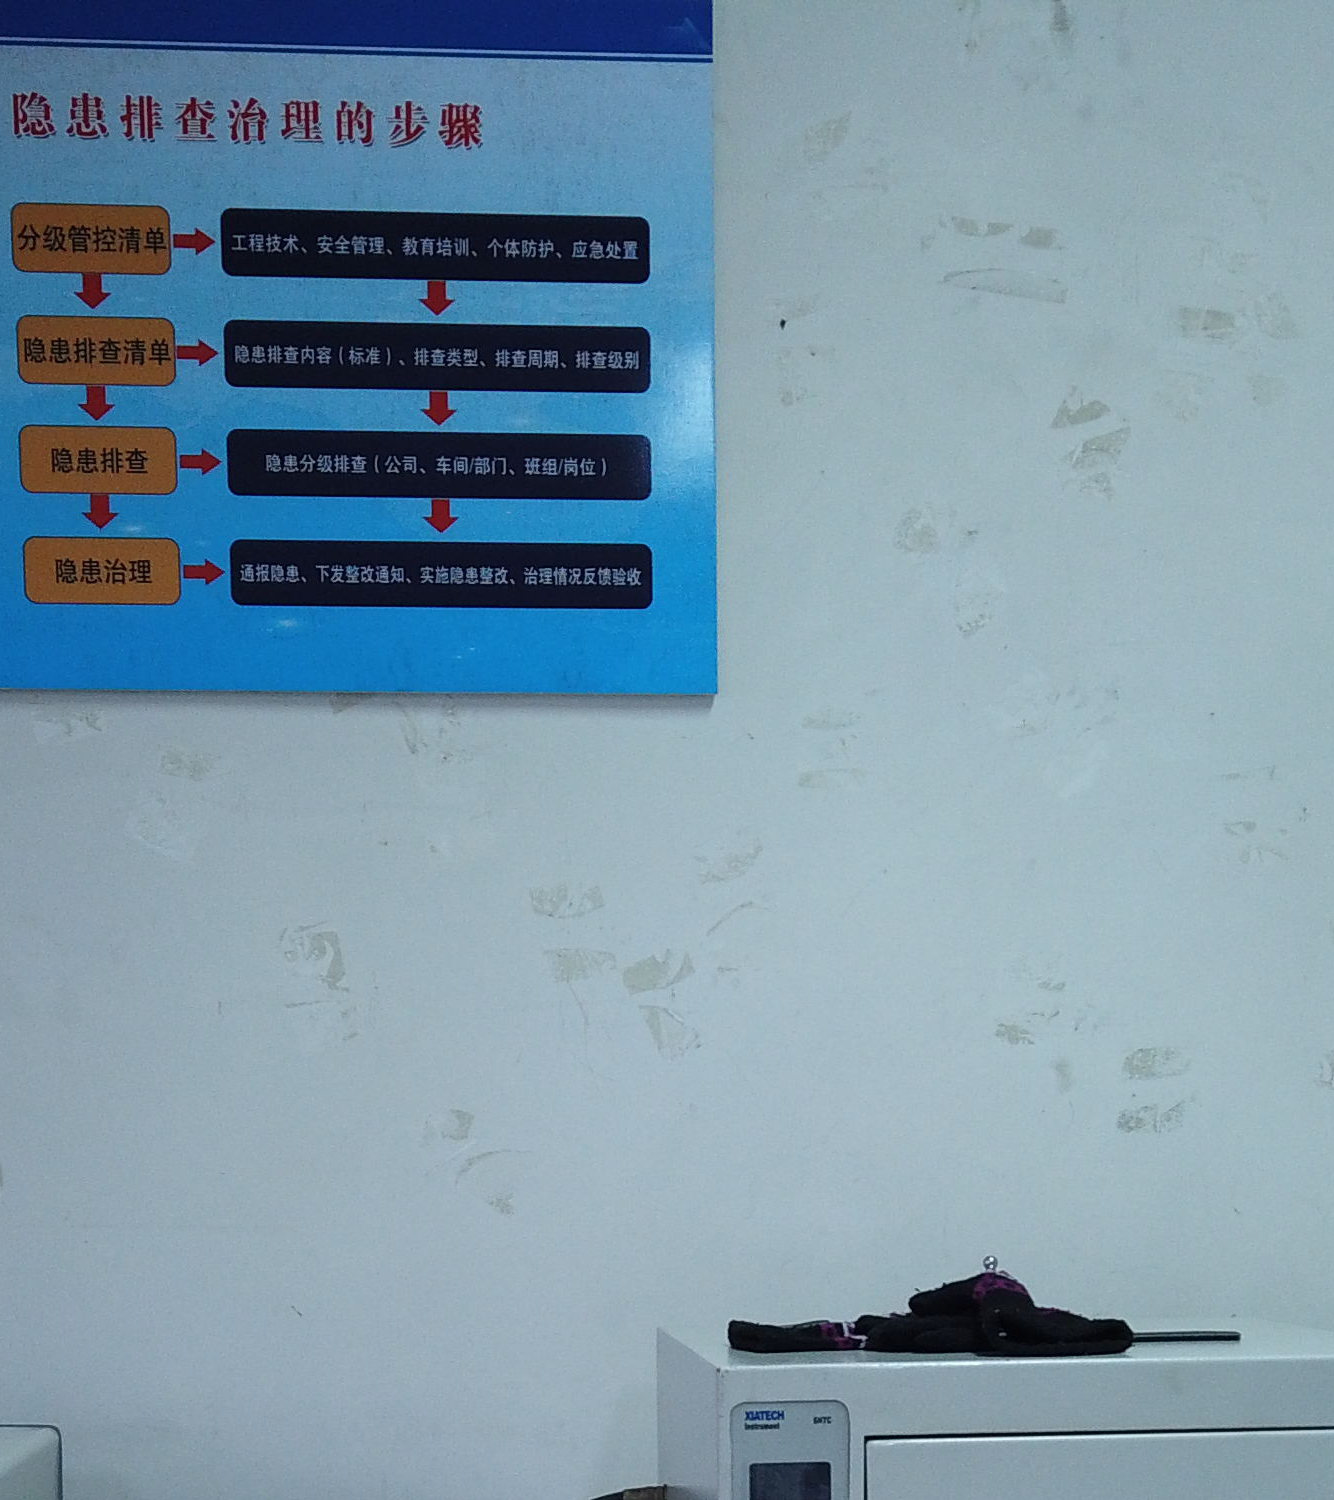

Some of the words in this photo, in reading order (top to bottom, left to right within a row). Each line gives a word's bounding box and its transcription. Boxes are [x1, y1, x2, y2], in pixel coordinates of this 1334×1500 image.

[11, 90, 485, 148] 隐患排查治理的步骤
[17, 223, 167, 255] 分级管控清单
[230, 233, 640, 262] 工程技术、安全管理、教育培训、个体防护、应急处置
[23, 336, 172, 367] 隐患排查清单
[51, 447, 149, 475] 隐患排查
[54, 556, 153, 585] 隐患治理
[744, 1410, 785, 1421] XIATECH
[744, 1422, 780, 1430] Instrument
